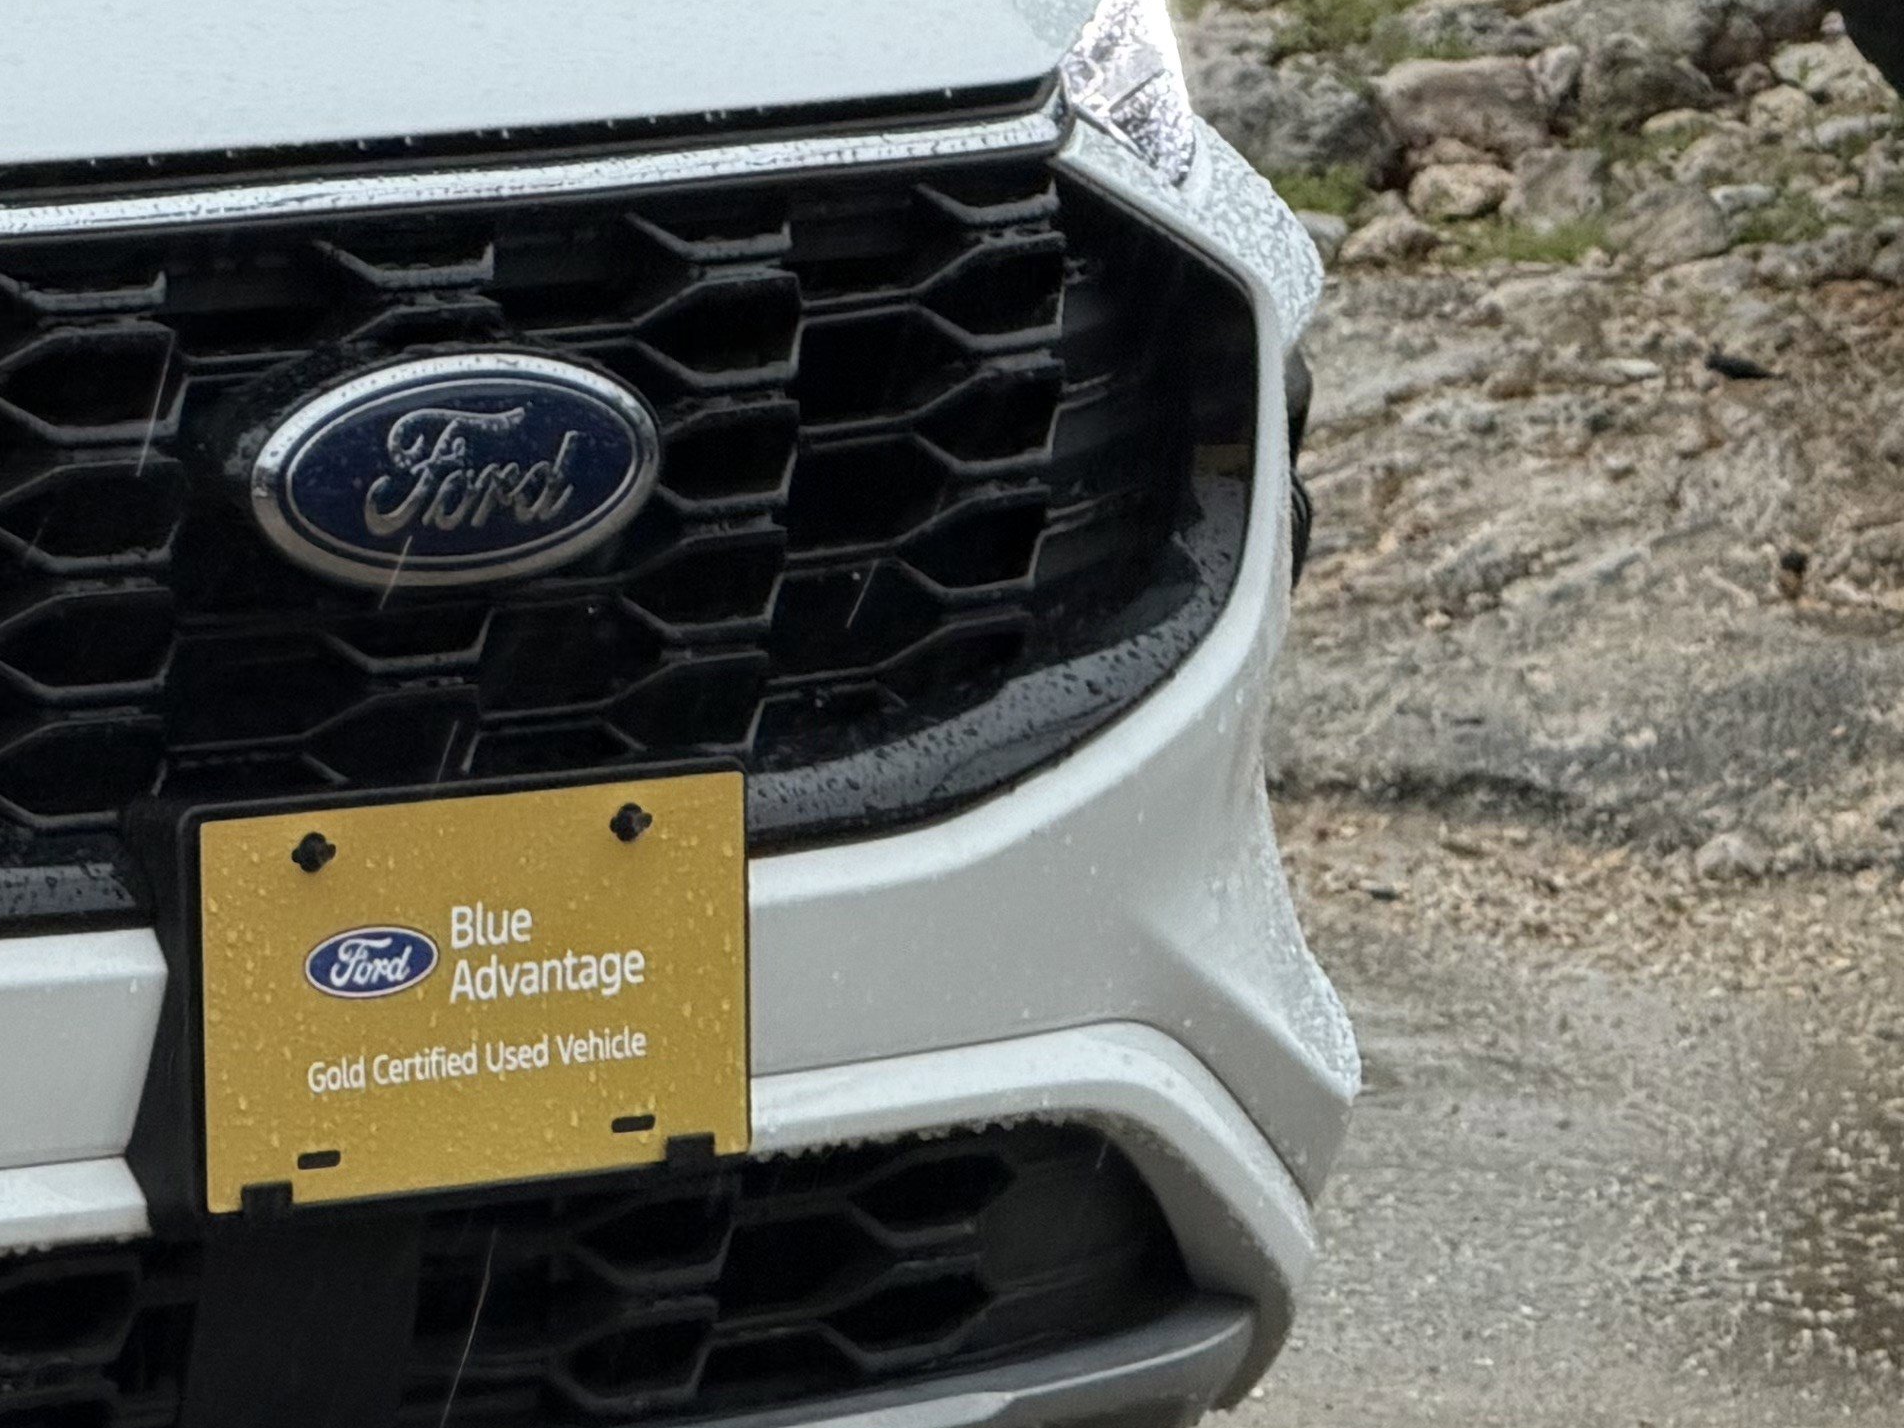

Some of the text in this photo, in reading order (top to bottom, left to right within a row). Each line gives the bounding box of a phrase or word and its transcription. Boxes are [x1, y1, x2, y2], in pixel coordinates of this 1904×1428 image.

[365, 407, 579, 536] Ford
[450, 901, 533, 949] Blue
[329, 937, 414, 987] Ford
[449, 948, 645, 1004] Advantage
[307, 1025, 647, 1093] Gold Certified Used Vehicle
